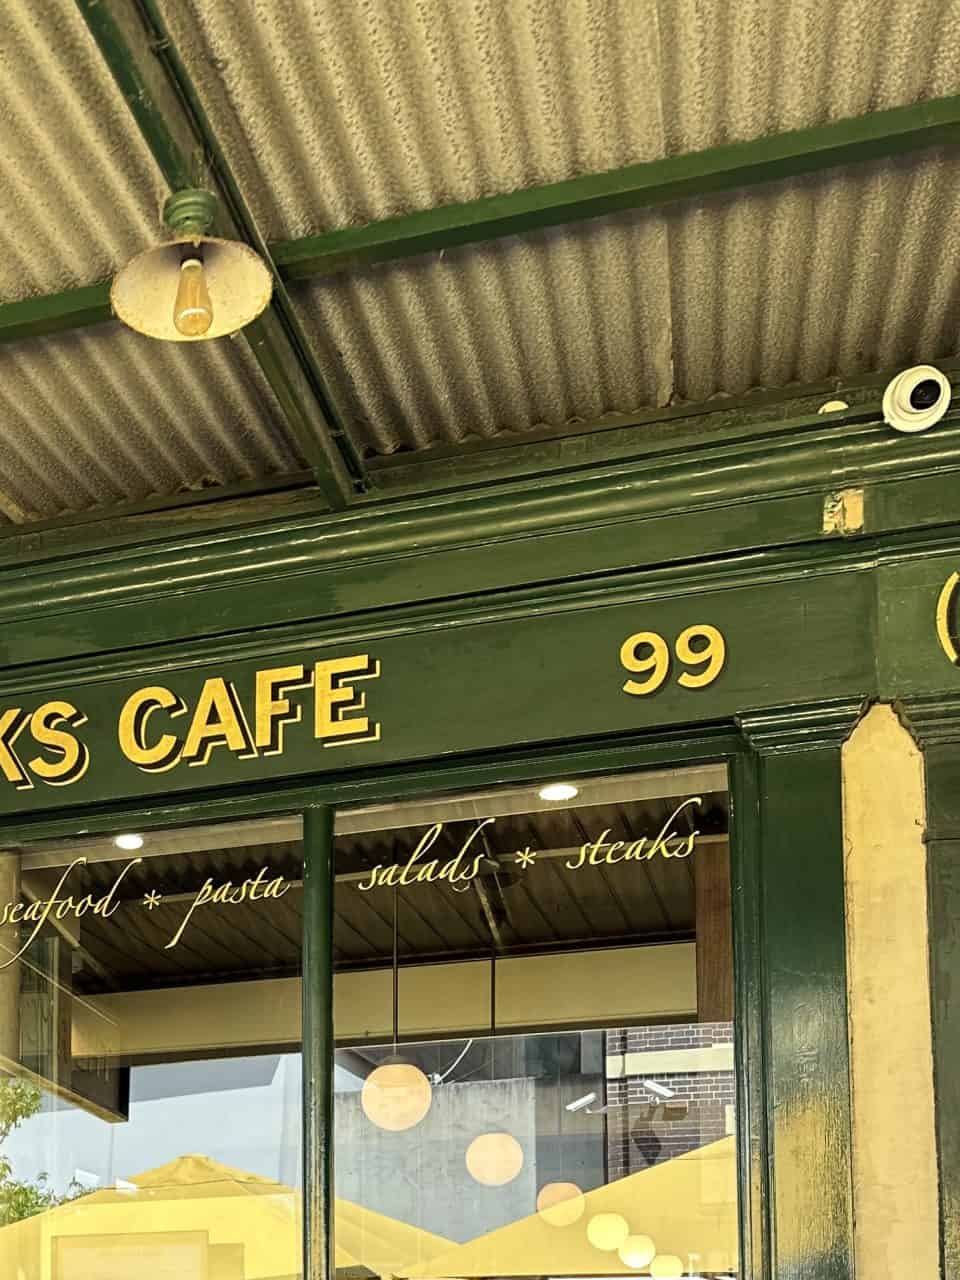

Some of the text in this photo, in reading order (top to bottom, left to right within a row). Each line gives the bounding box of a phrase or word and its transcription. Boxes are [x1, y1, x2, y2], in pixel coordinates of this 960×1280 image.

[619, 624, 726, 695] 99
[118, 654, 381, 773] CAFE
[358, 797, 702, 892] salads steaks
[165, 866, 292, 949] pasta
